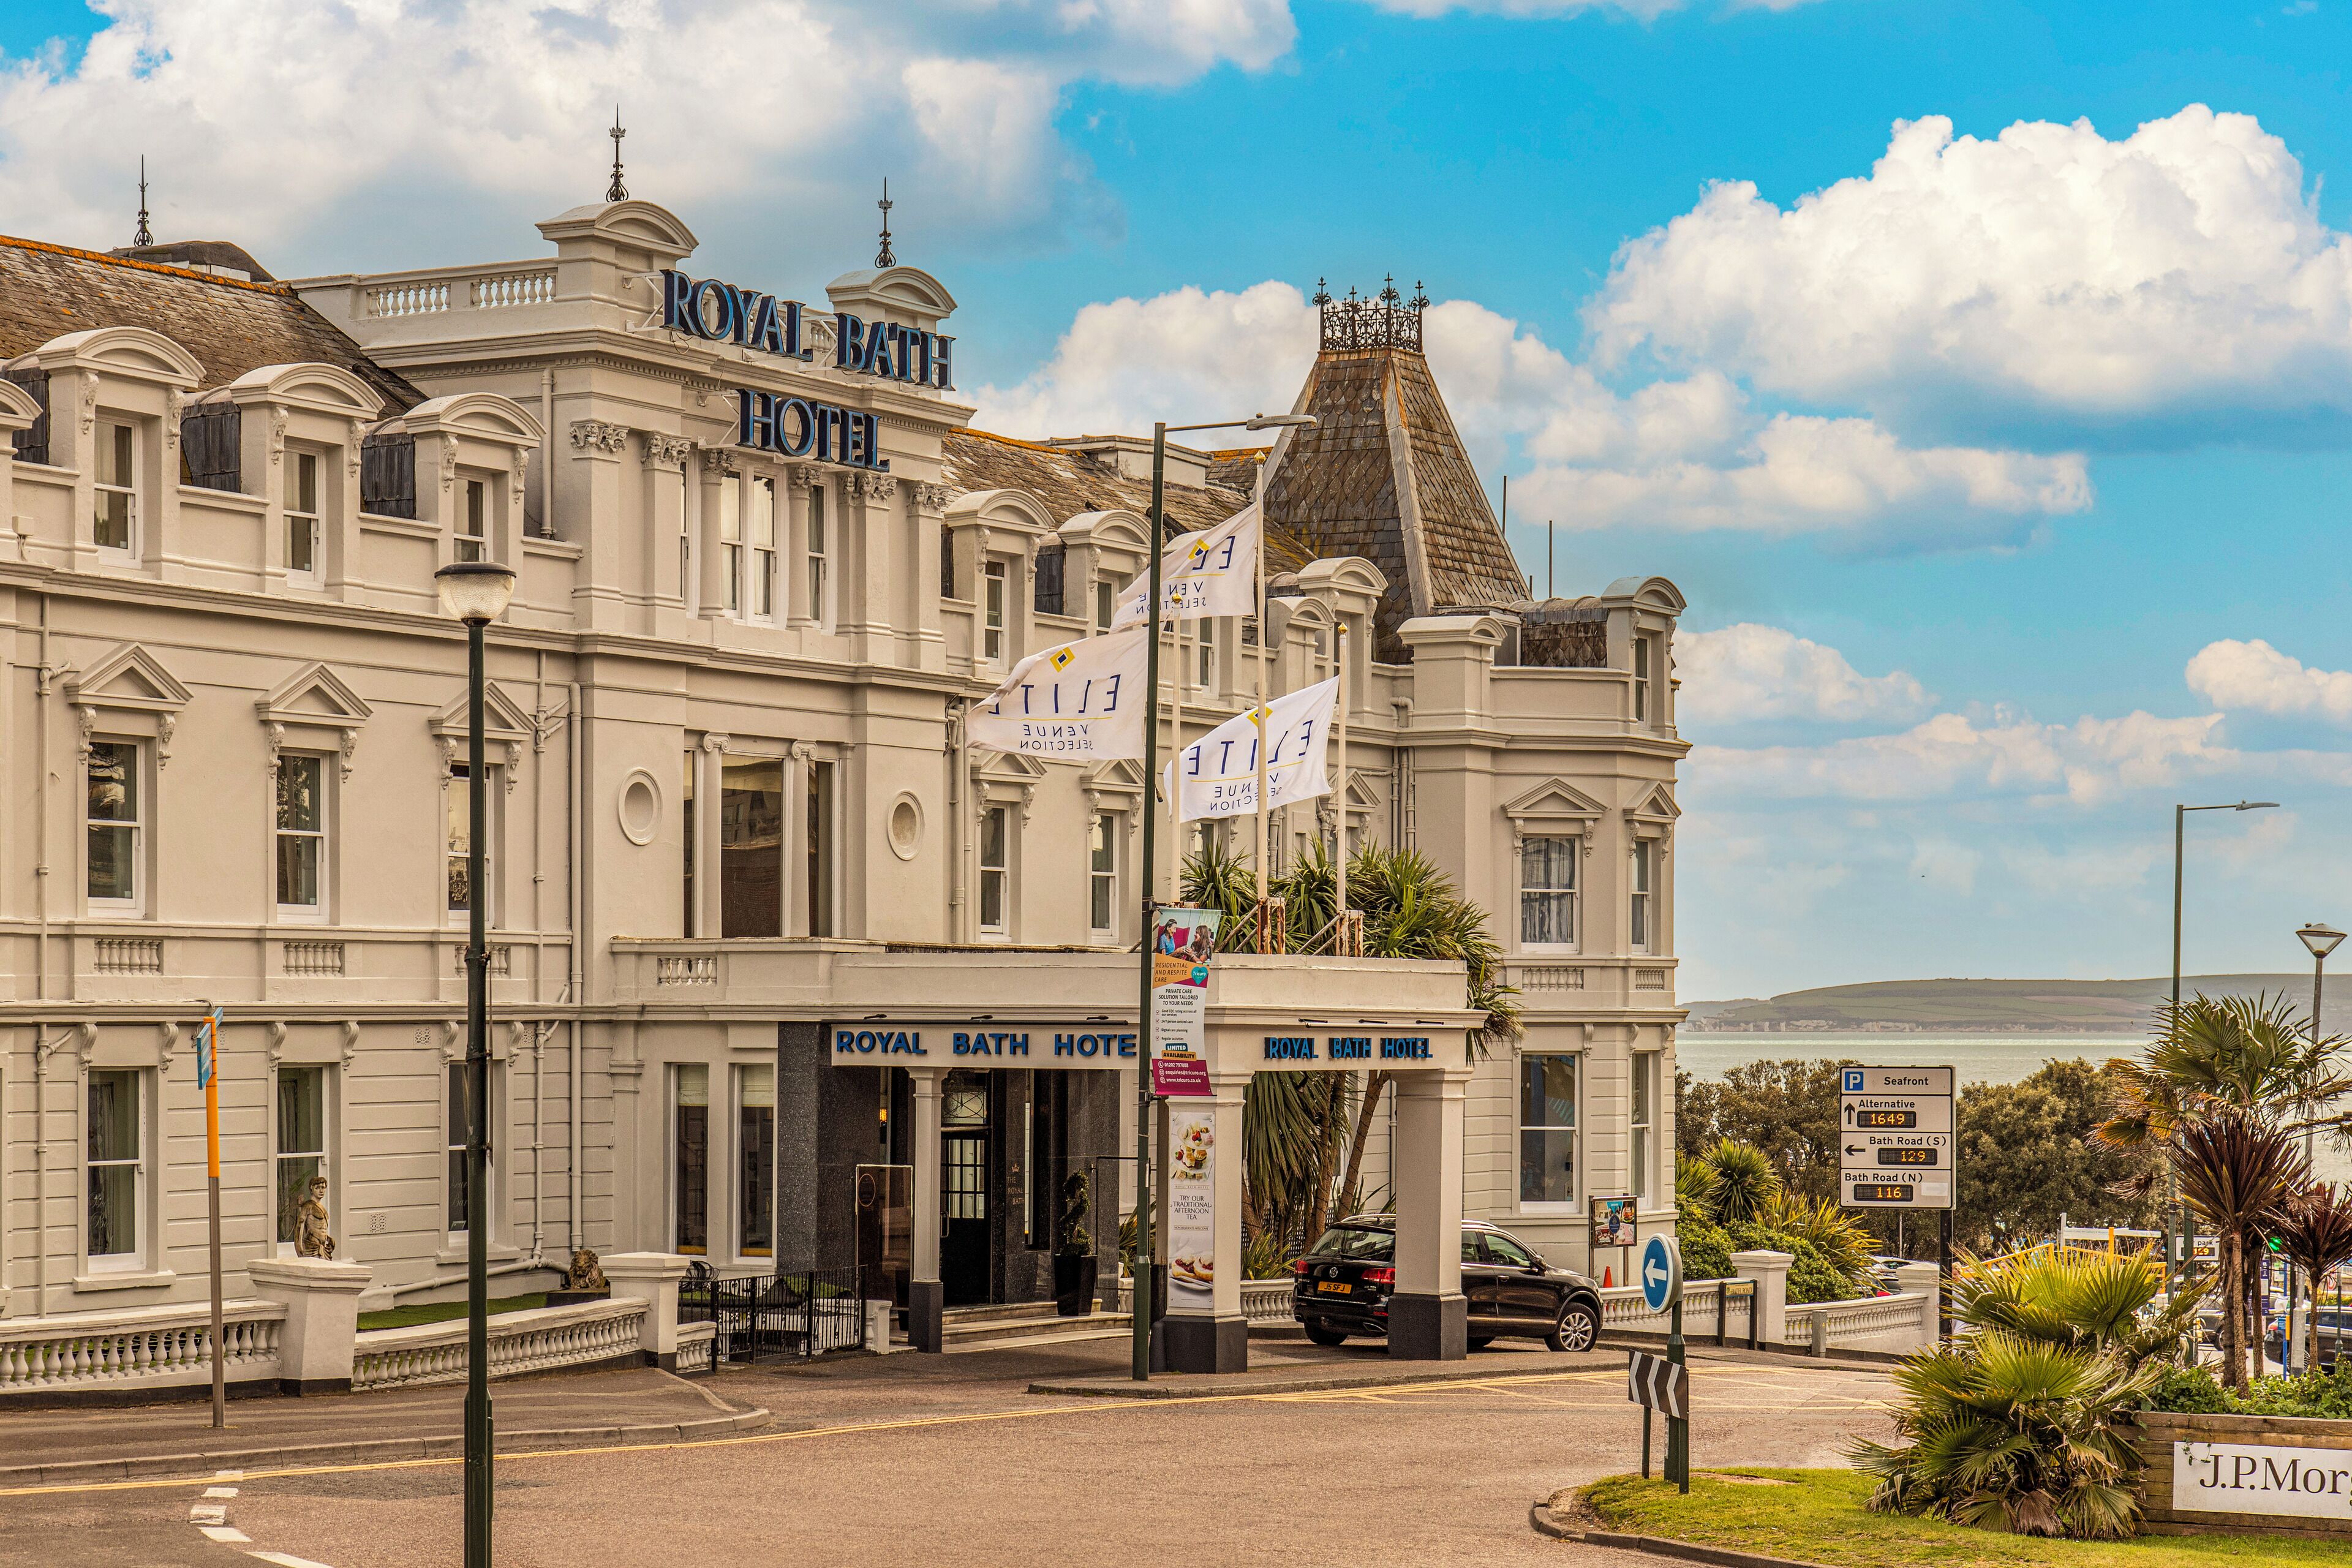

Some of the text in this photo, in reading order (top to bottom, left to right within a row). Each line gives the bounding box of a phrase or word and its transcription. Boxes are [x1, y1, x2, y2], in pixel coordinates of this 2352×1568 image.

[660, 269, 957, 391] ROYAL BATH
[736, 388, 890, 472] HOTEL
[837, 1031, 1137, 1056] ROYAL BATH HOTE
[1265, 1037, 1433, 1059] ROYAL BATH HOTEL
[1849, 1074, 1929, 1089] P Seafront
[1858, 1099, 1915, 1108] Alternative
[1871, 1113, 1905, 1125] 1649
[1869, 1136, 1947, 1147] Bath Road (S)
[1901, 1150, 1926, 1161] 129
[1845, 1172, 1923, 1183] Bath Road (N)
[1877, 1186, 1902, 1198] 116
[2199, 1455, 2352, 1510] J.P.Mor
